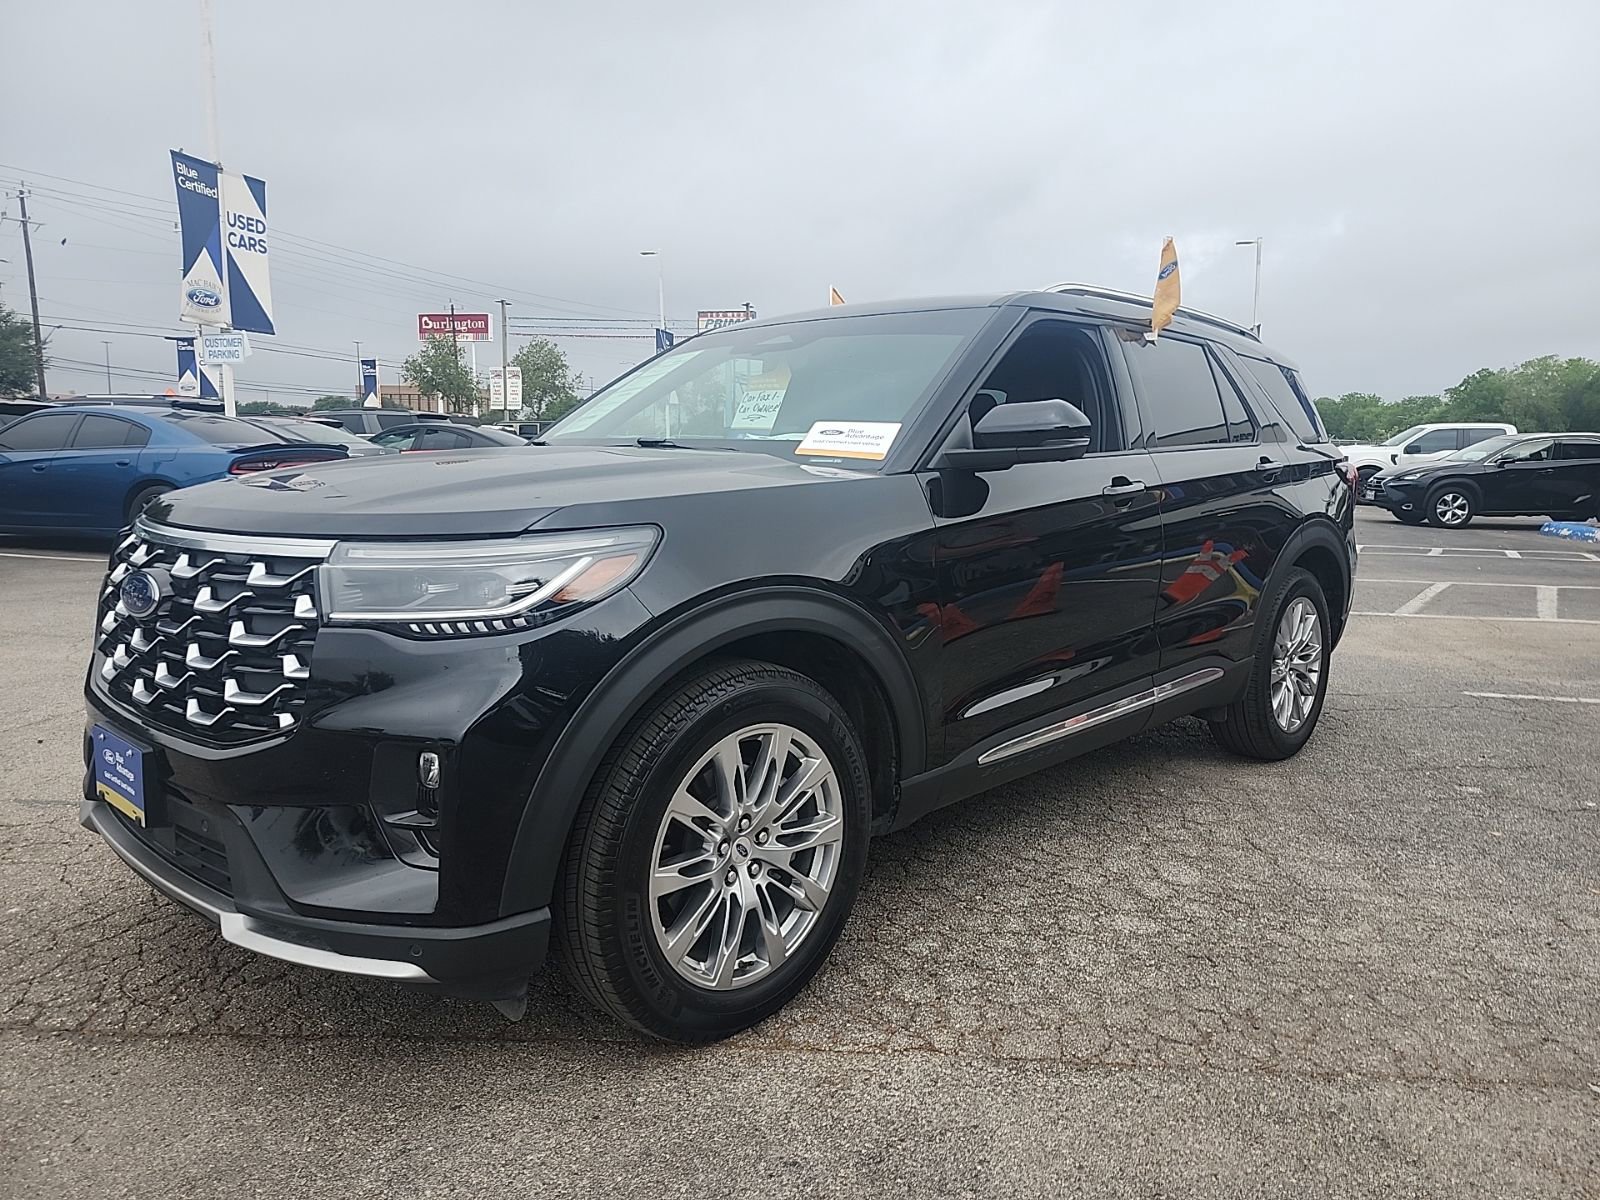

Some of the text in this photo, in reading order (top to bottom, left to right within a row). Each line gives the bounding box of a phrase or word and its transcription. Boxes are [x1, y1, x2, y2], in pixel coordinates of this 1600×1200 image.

[176, 162, 198, 178] Blue
[178, 177, 218, 199] Certified
[226, 211, 266, 234] USED
[228, 232, 267, 254] CARS
[193, 289, 217, 306] Ford
[421, 316, 486, 332] Burlington
[204, 338, 242, 348] CUSTOMER
[208, 350, 240, 359] PARKING
[625, 897, 661, 990] MICHELIN
